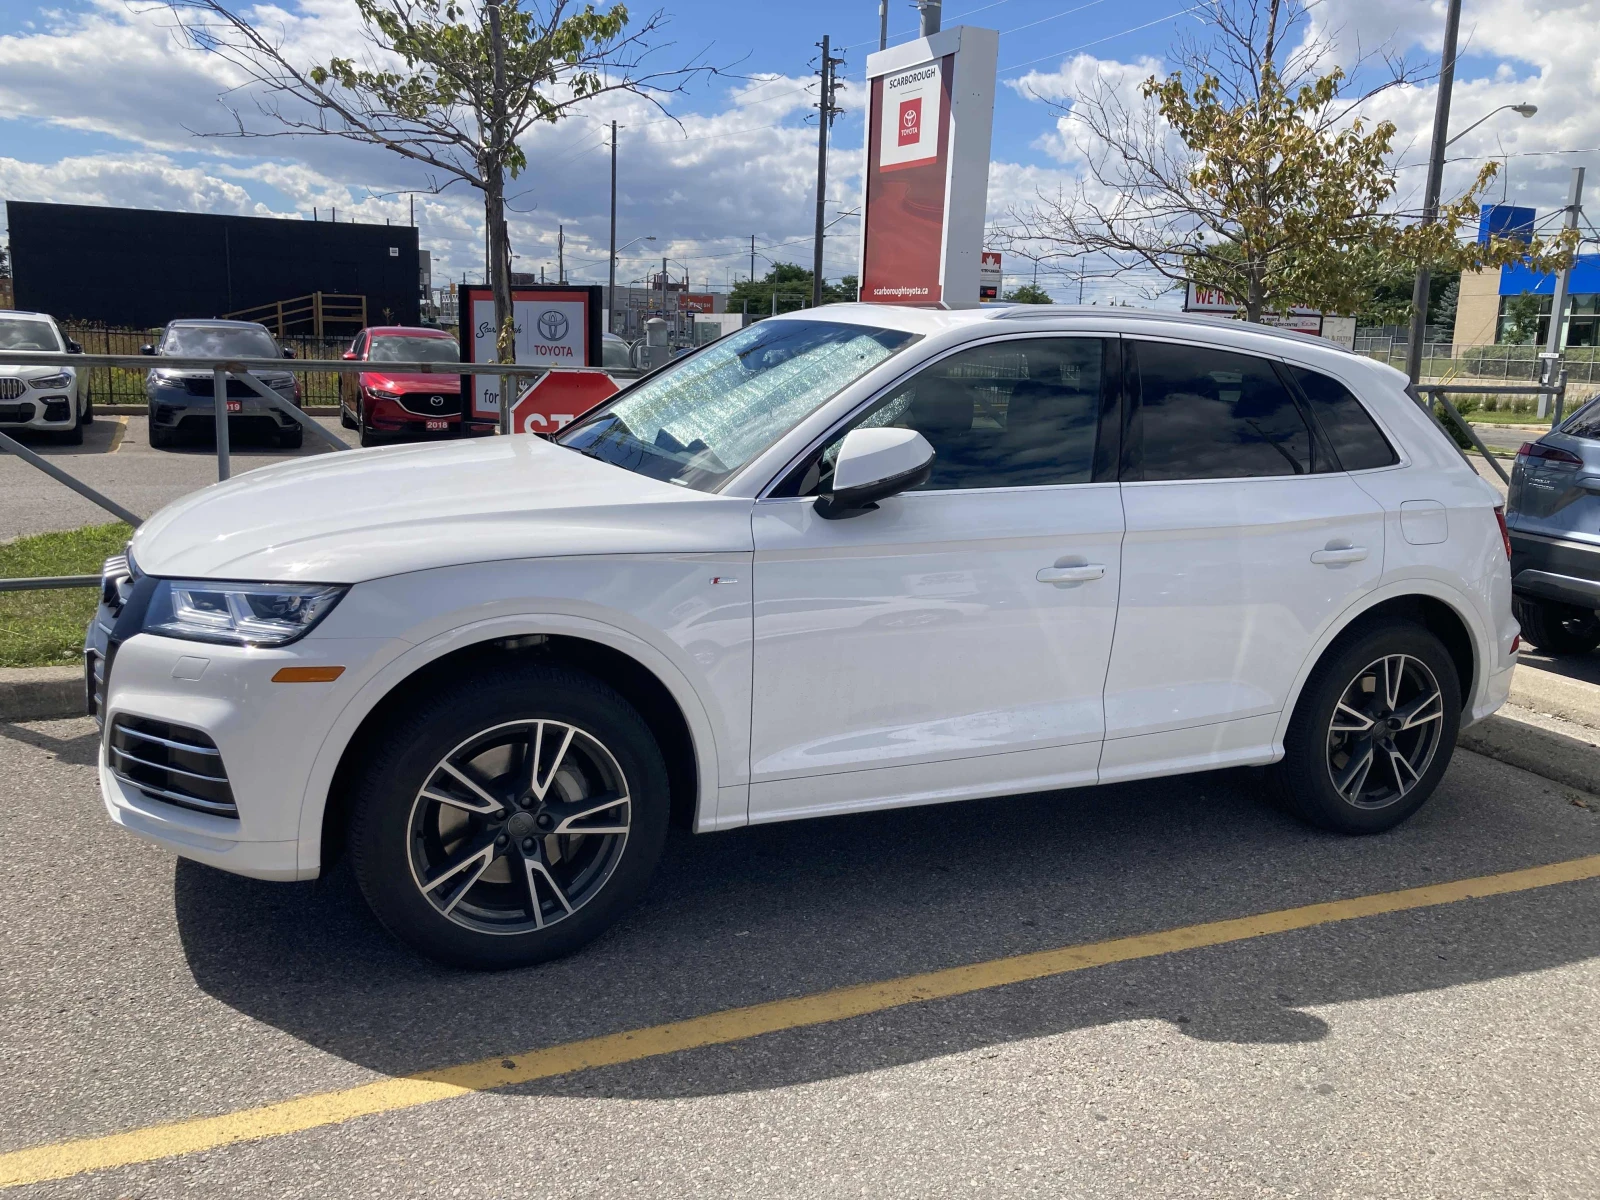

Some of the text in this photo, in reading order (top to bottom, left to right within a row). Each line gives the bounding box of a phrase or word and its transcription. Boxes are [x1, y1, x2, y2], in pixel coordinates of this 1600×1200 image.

[889, 68, 936, 89] SCARBOROUGH
[901, 127, 918, 136] TOYOTA
[873, 286, 929, 297] scarboroughtoyota.ca
[534, 345, 574, 357] TOYOTA
[427, 421, 448, 429] 2018
